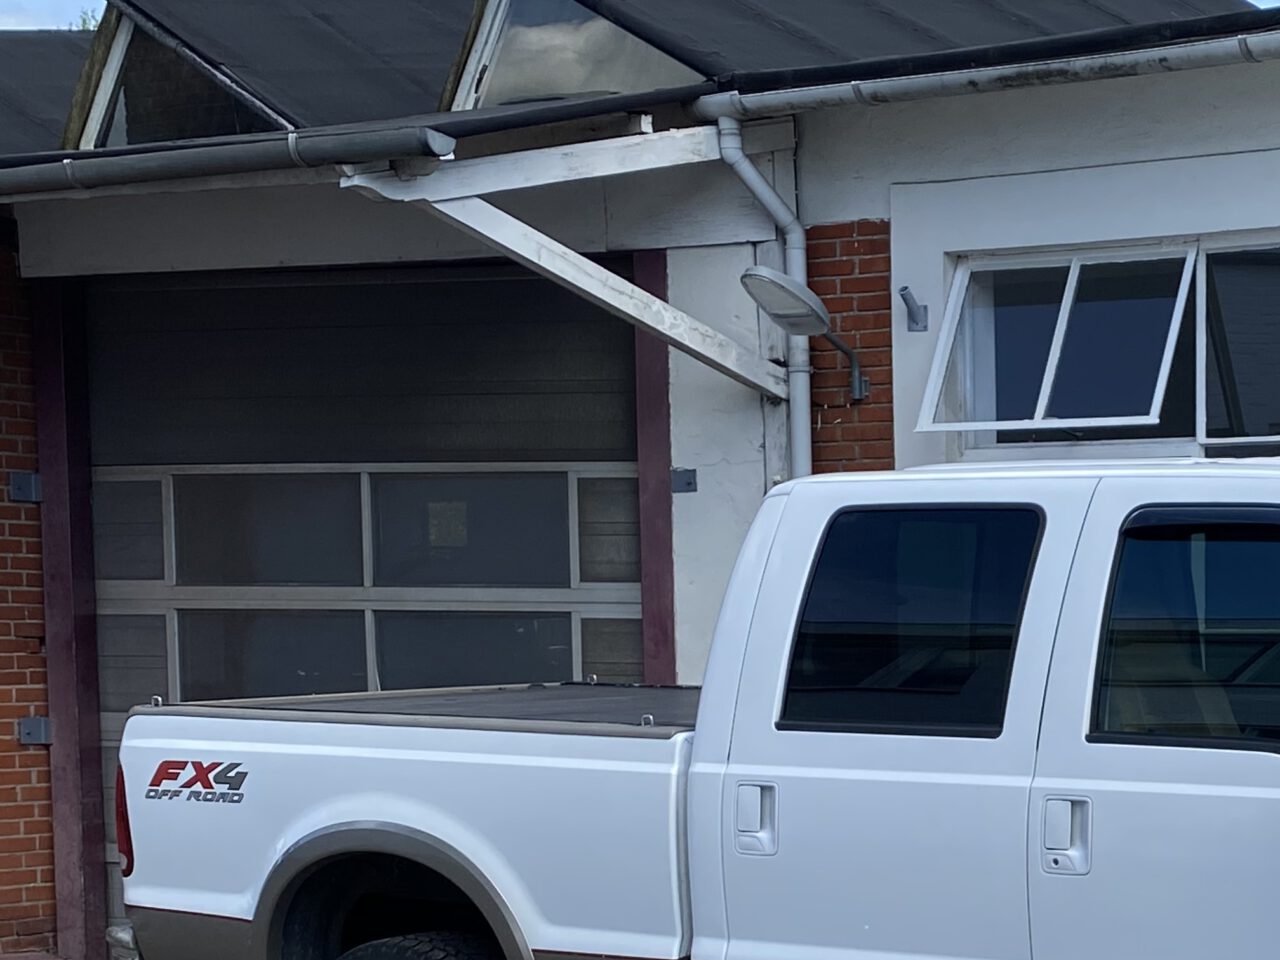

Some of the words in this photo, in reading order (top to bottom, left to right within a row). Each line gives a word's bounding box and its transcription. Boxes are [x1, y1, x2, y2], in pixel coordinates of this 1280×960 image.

[148, 760, 249, 791] FX4
[145, 788, 183, 800] OFF
[186, 790, 245, 804] ROAD
